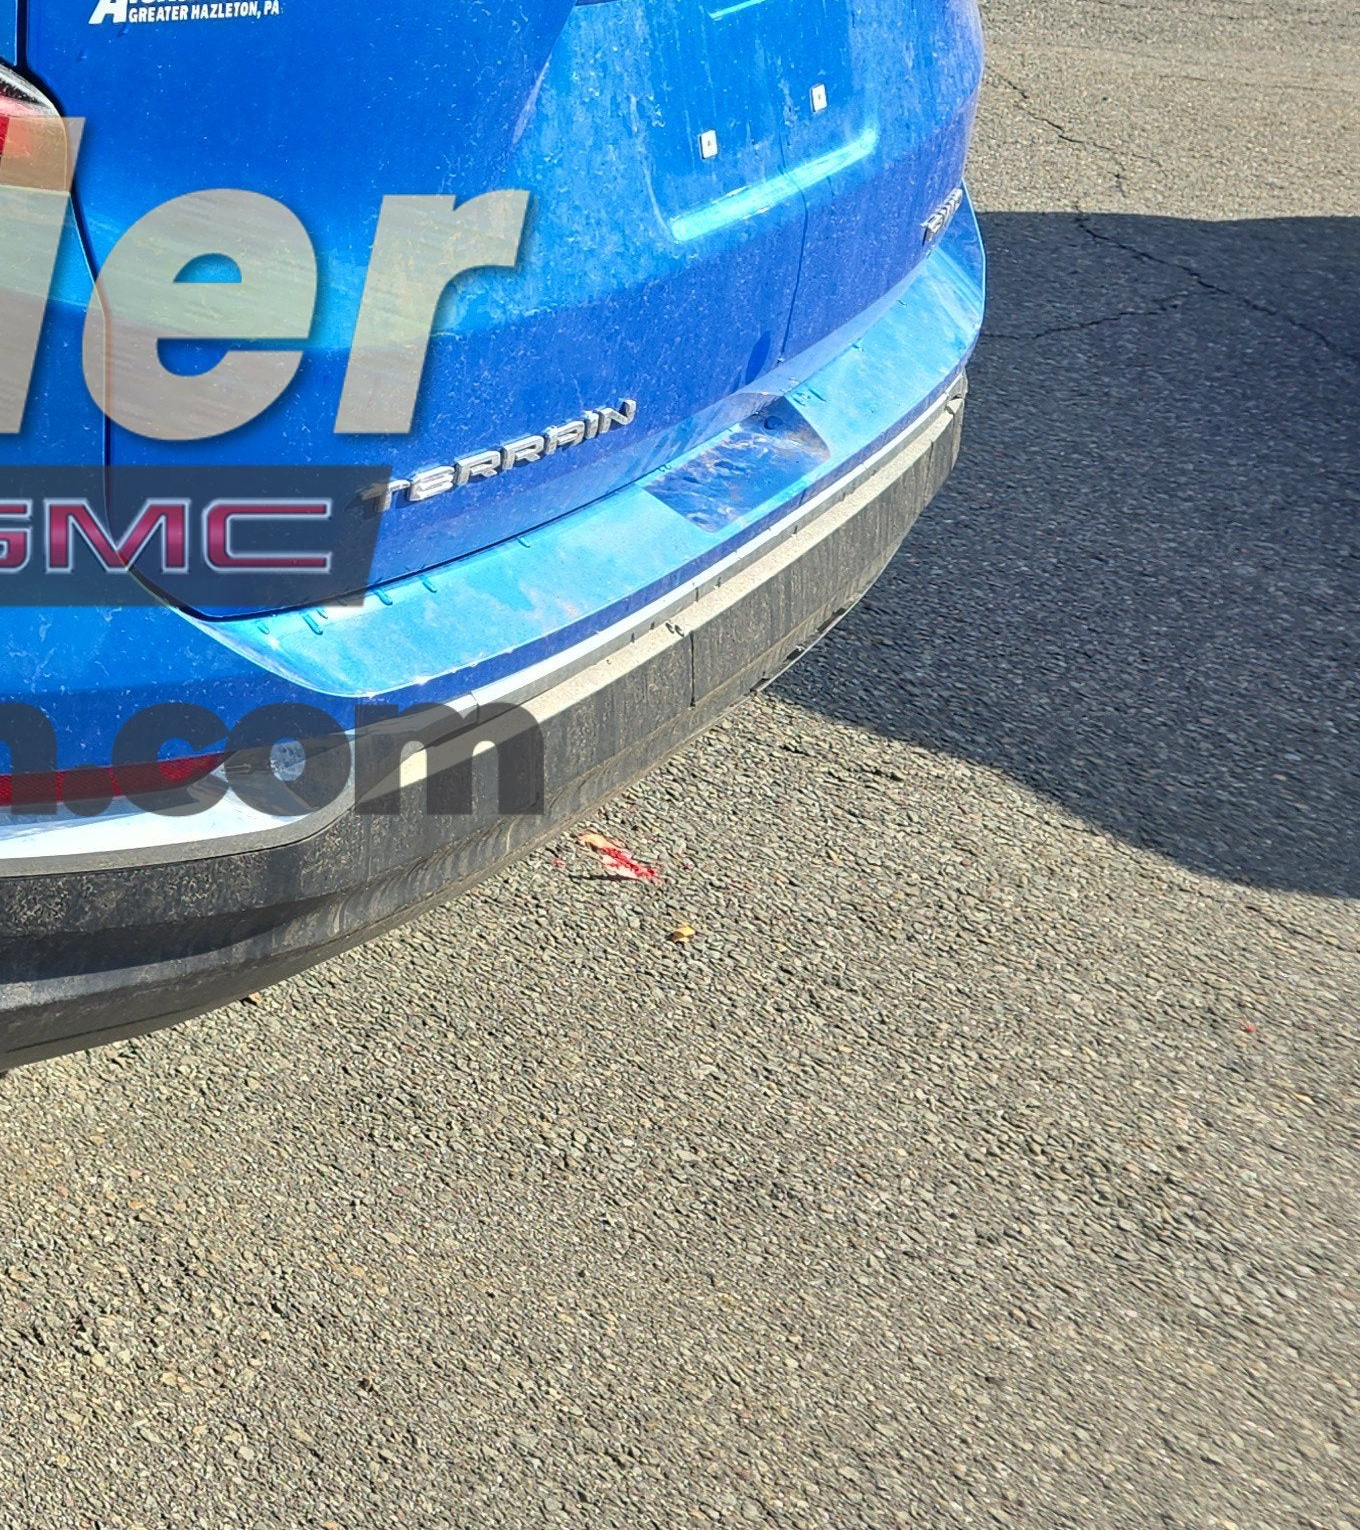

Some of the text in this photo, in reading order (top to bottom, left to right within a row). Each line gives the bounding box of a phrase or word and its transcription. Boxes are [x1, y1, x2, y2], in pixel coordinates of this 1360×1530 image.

[128, 0, 280, 23] GREATER HAZLETON, PA
[360, 399, 637, 512] TERRAIN
